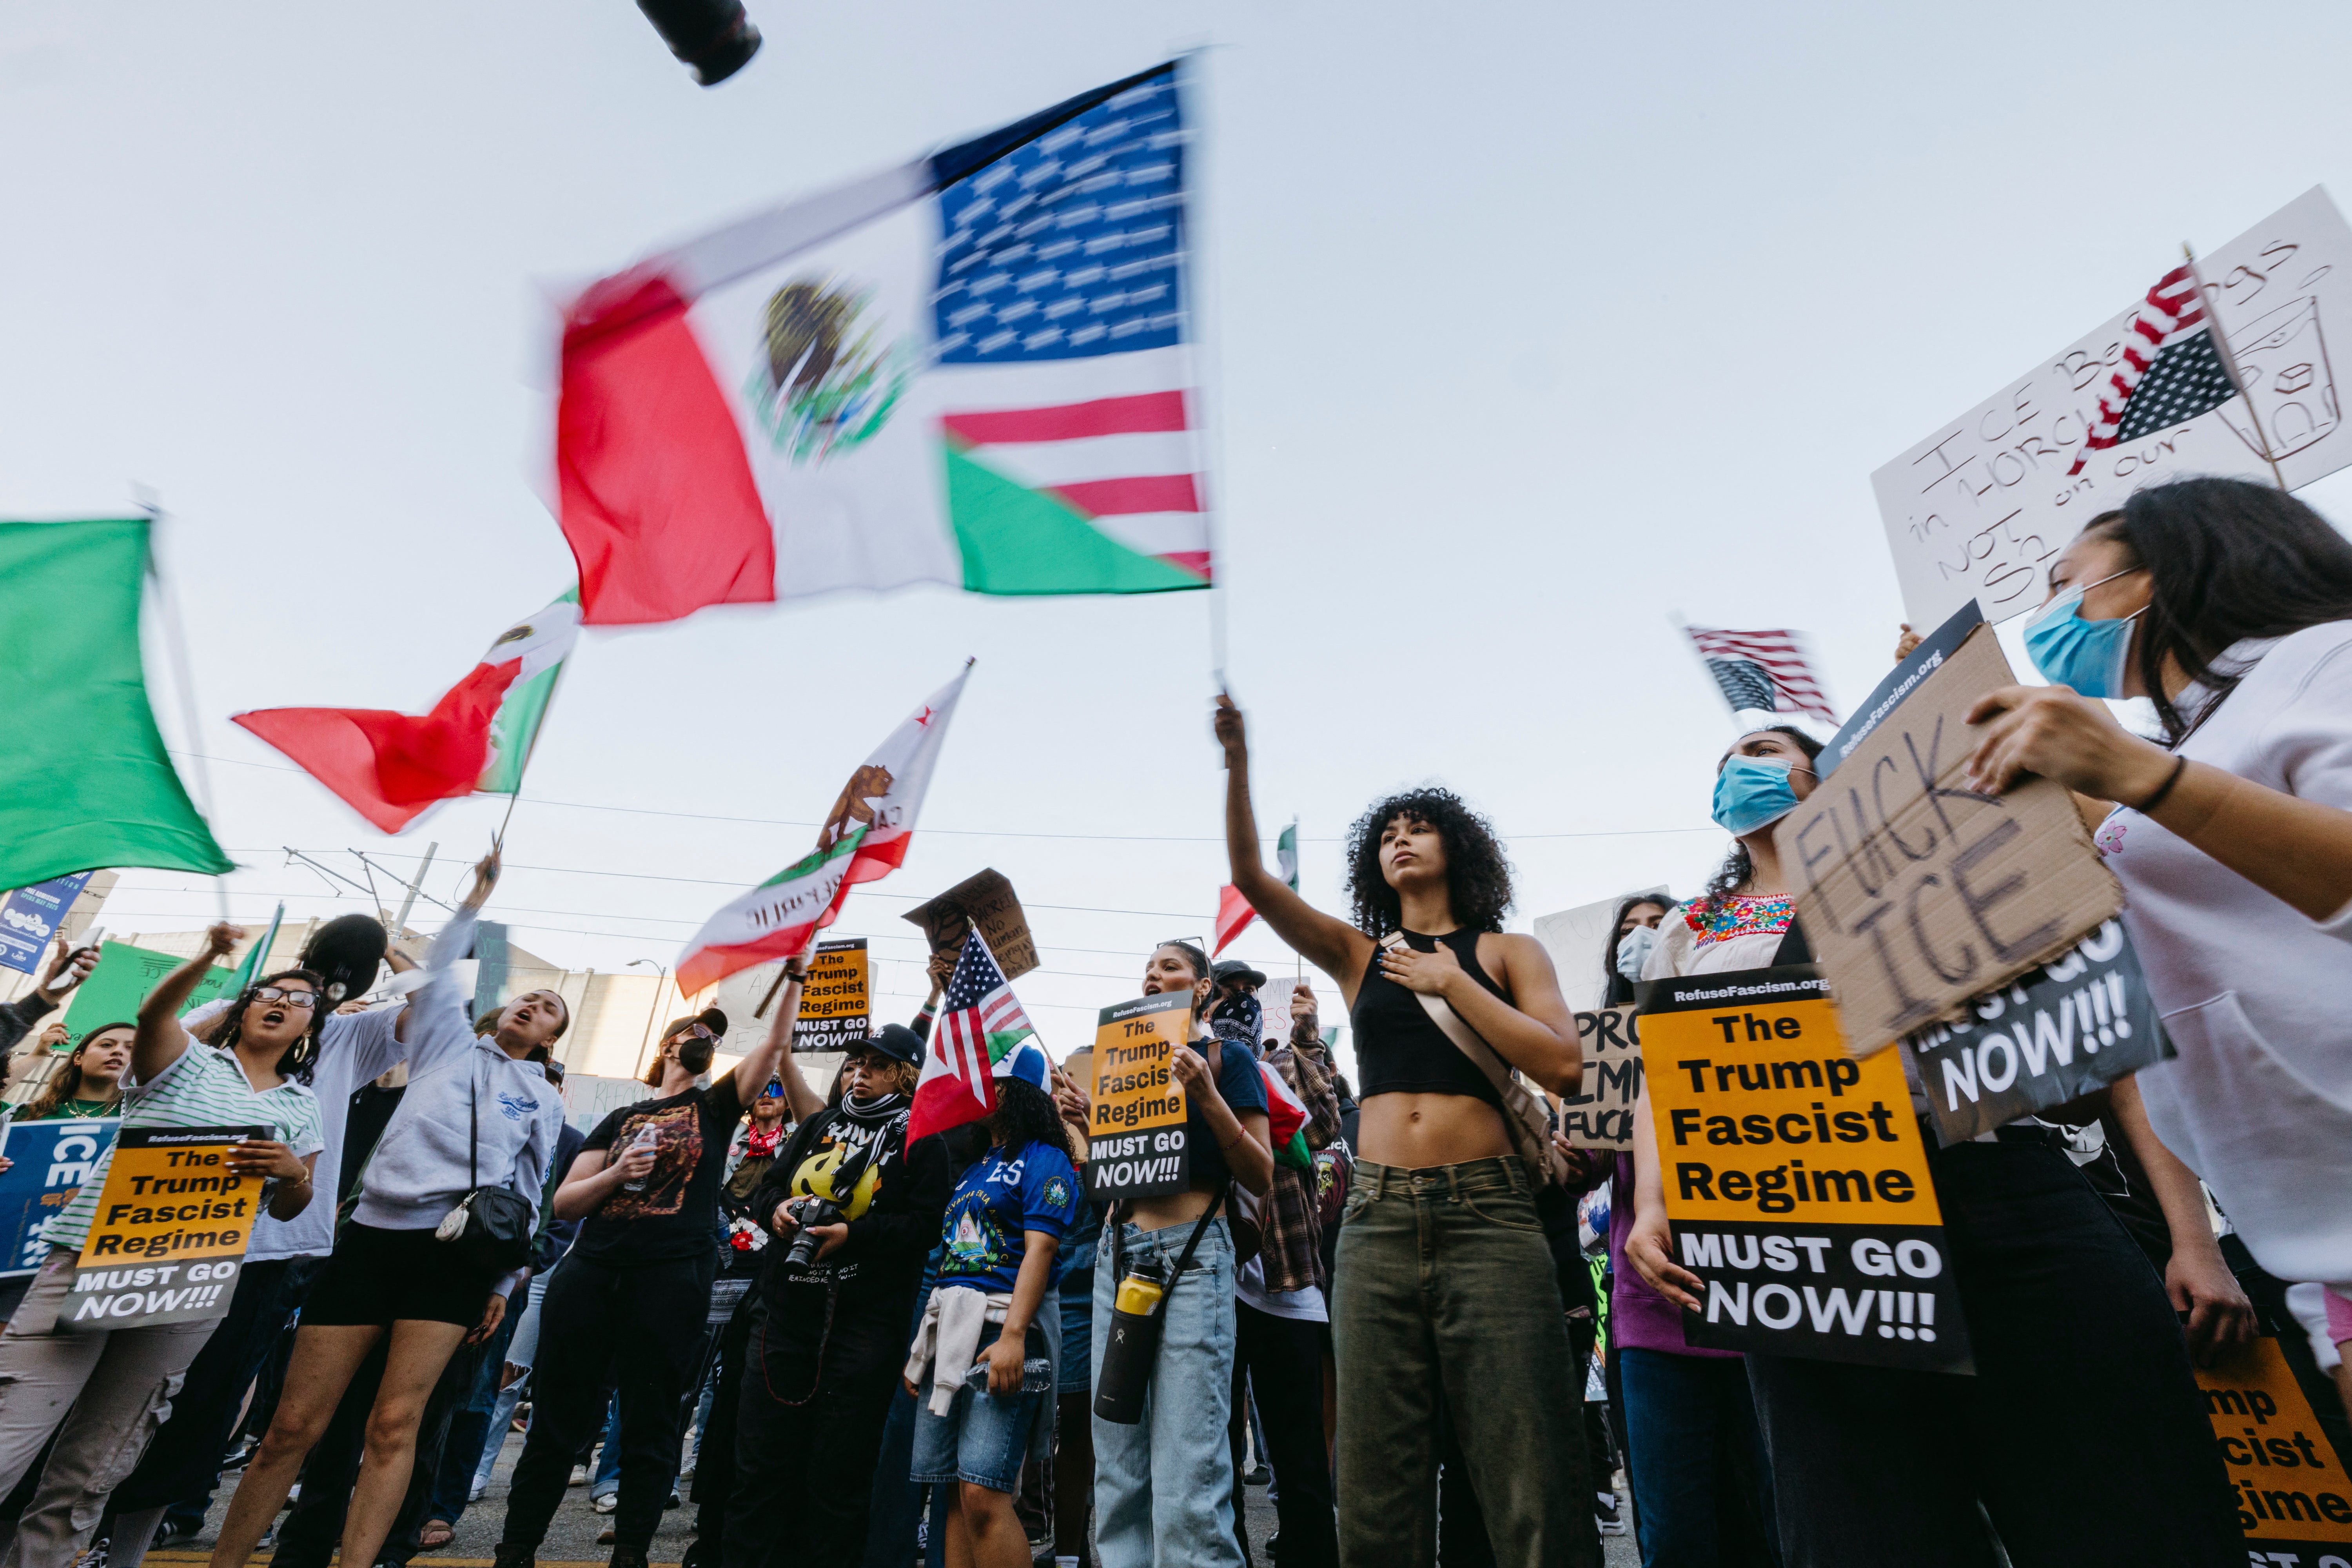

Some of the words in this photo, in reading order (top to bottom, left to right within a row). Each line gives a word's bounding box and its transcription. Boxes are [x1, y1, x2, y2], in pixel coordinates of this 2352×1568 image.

[1912, 382, 2041, 494] ICE
[1938, 508, 2024, 581] NOT
[2056, 478, 2094, 506] on
[2114, 428, 2191, 476] our
[1909, 514, 1949, 543] in
[1838, 649, 1944, 758] RefuseFascism.org
[1795, 713, 2006, 938] FUCK
[985, 920, 1005, 936] NO
[1853, 817, 2072, 1032] ICE
[816, 943, 855, 951] useFascism.org
[819, 955, 844, 965] The
[801, 980, 864, 997] Fascist
[807, 967, 858, 981] Trump
[1674, 978, 1831, 1002] RefuseFascism.org
[800, 999, 866, 1015] Regime
[1112, 1000, 1173, 1019] RefuseFascism.org
[1262, 1006, 1286, 1029] ES
[795, 1020, 840, 1032] MUST
[844, 1018, 867, 1030] GO
[1123, 1021, 1155, 1038] The
[1713, 1013, 1801, 1043] The
[1105, 1039, 1171, 1066] Trump
[1941, 969, 2132, 1112] NOW!!!
[1678, 1057, 1860, 1096] Trump
[1096, 1095, 1181, 1127] Regime
[1671, 1102, 1900, 1145] Fascist
[44, 1124, 102, 1188] ICE
[166, 1150, 220, 1167] The
[1091, 1135, 1149, 1160] MUST
[1154, 1130, 1185, 1154] GO
[131, 1176, 241, 1196] Trump
[1095, 1156, 1181, 1189] NOW!!!
[1676, 1159, 1916, 1214] Regime
[105, 1197, 248, 1226] Fascist
[93, 1228, 241, 1258] Regime
[1680, 1233, 1832, 1273] MUST
[1851, 1238, 1942, 1279] GO
[76, 1265, 179, 1293] MUST
[187, 1261, 236, 1282] GO
[788, 1274, 820, 1283] REMINDED
[73, 1284, 222, 1321] NOW!!!
[1706, 1280, 1937, 1343] NOW!!!
